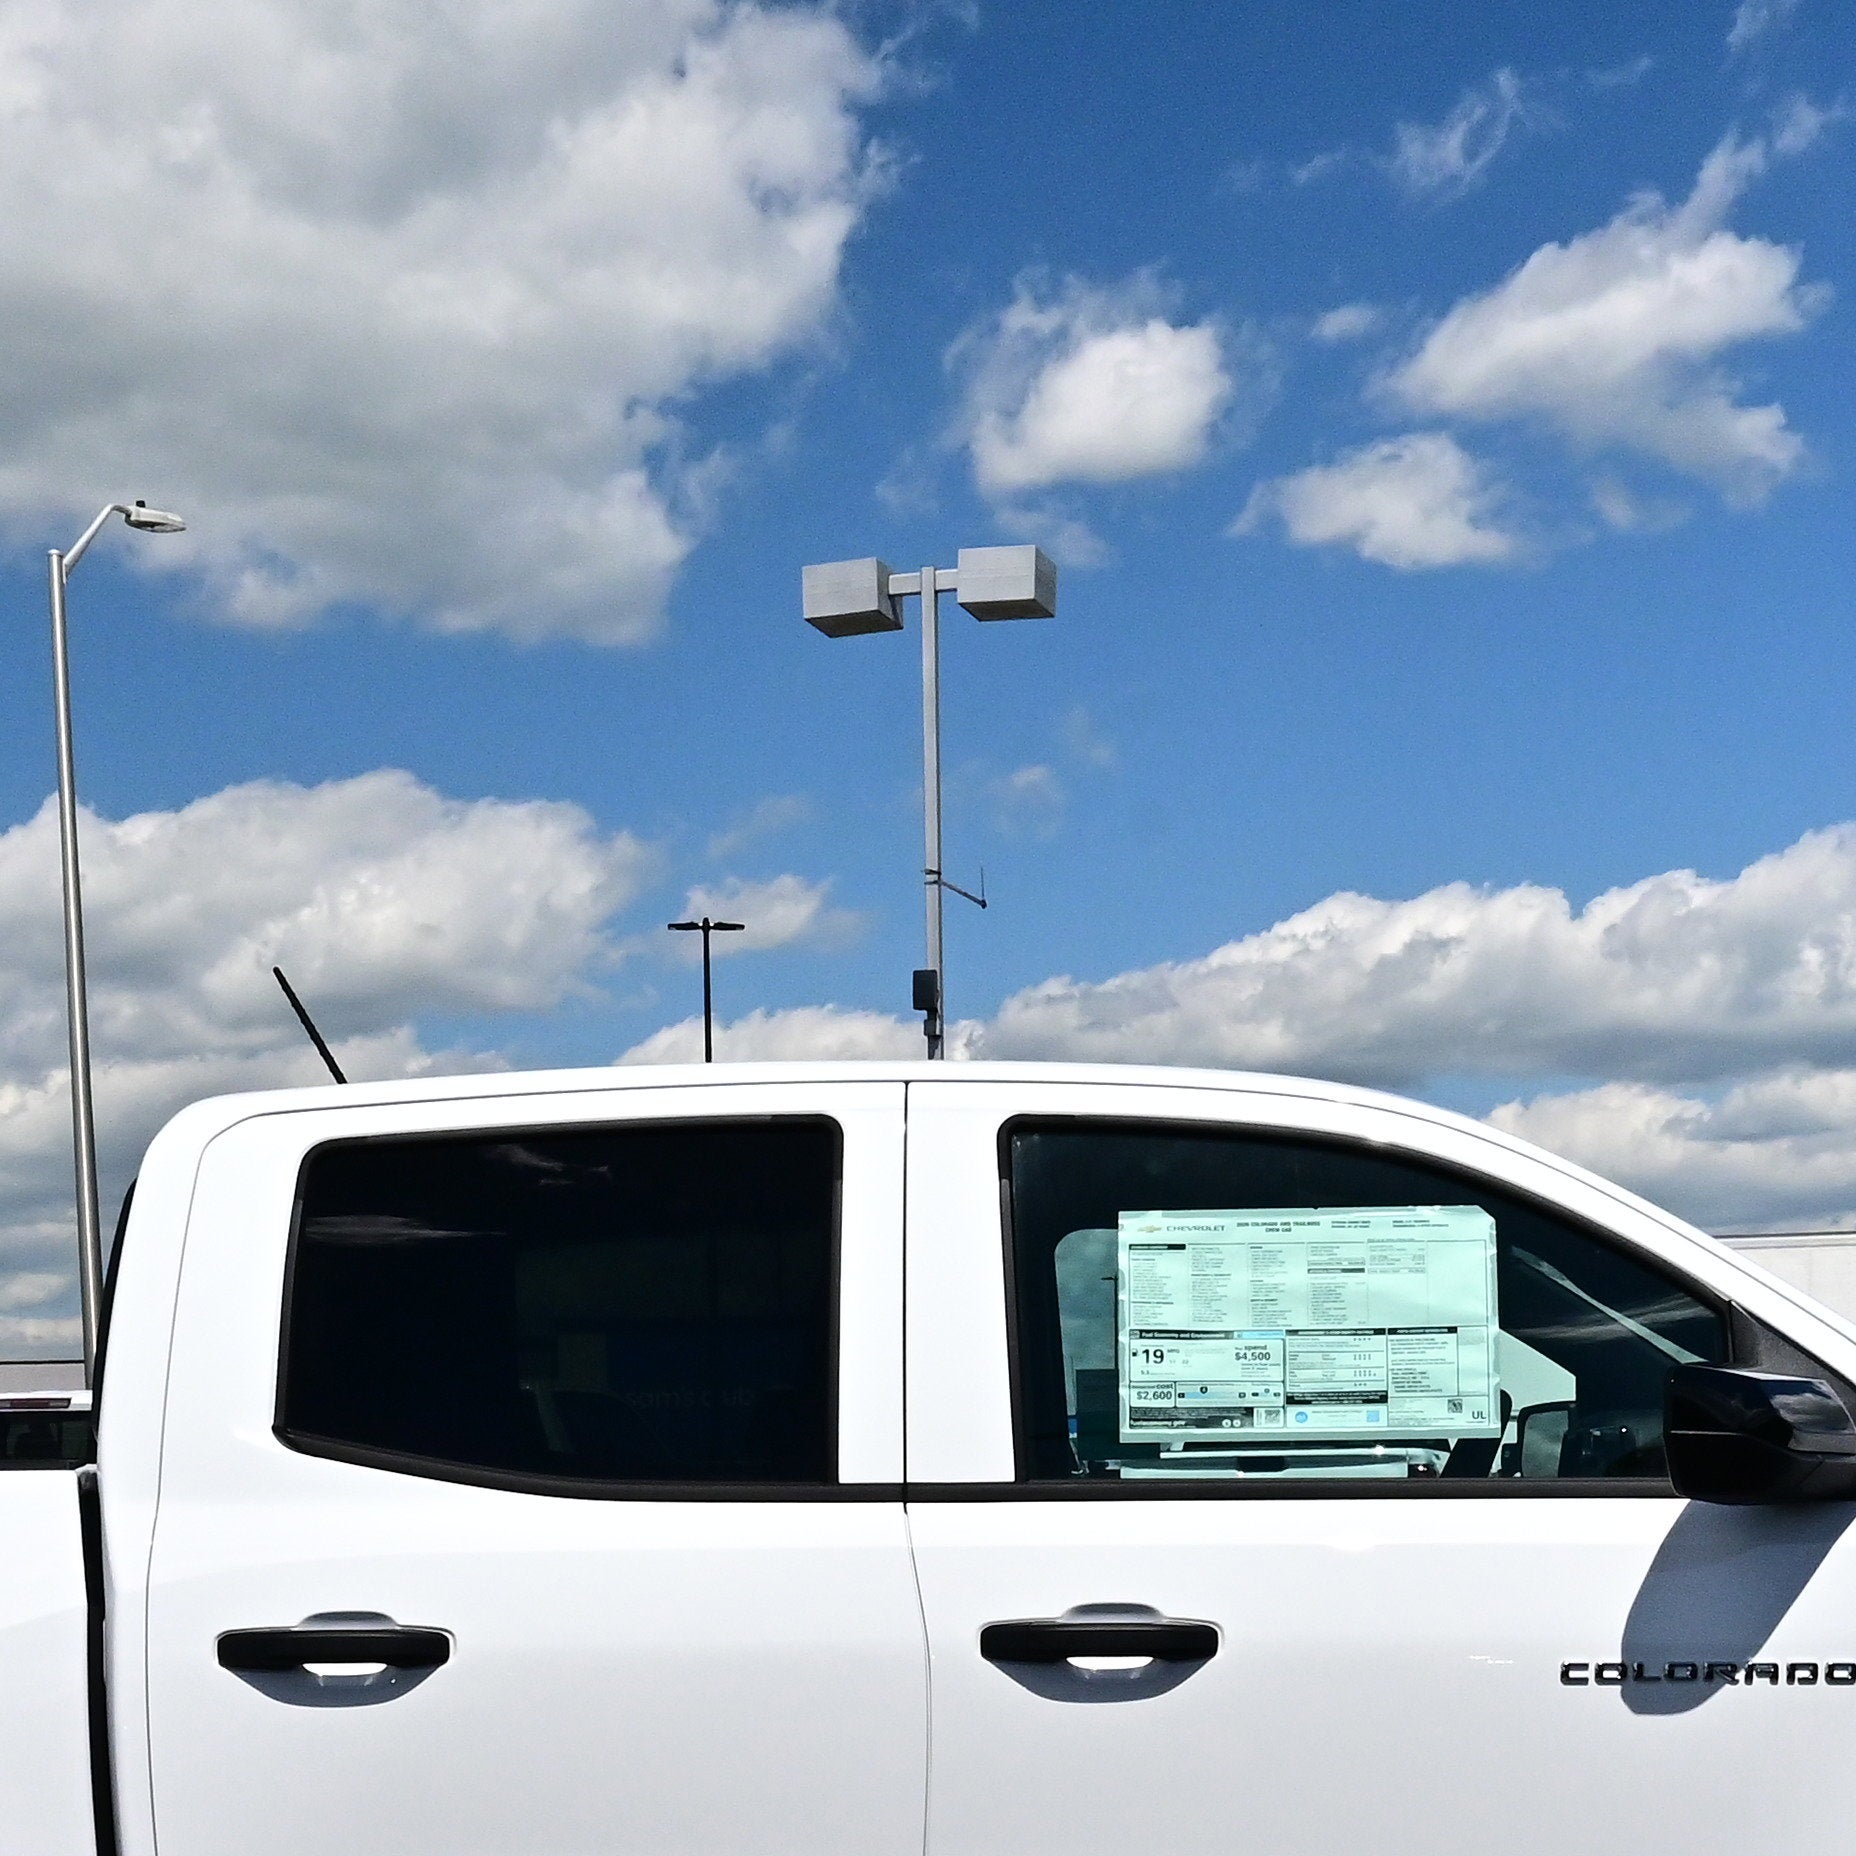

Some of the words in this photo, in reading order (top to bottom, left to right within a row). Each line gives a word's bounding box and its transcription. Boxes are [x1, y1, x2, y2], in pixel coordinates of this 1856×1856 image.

[1166, 1224, 1226, 1232] CHEVROLET
[1141, 1348, 1165, 1364] 19
[1234, 1352, 1271, 1361] $4,500
[1136, 1390, 1173, 1400] $2,600
[1472, 1410, 1487, 1420] UL
